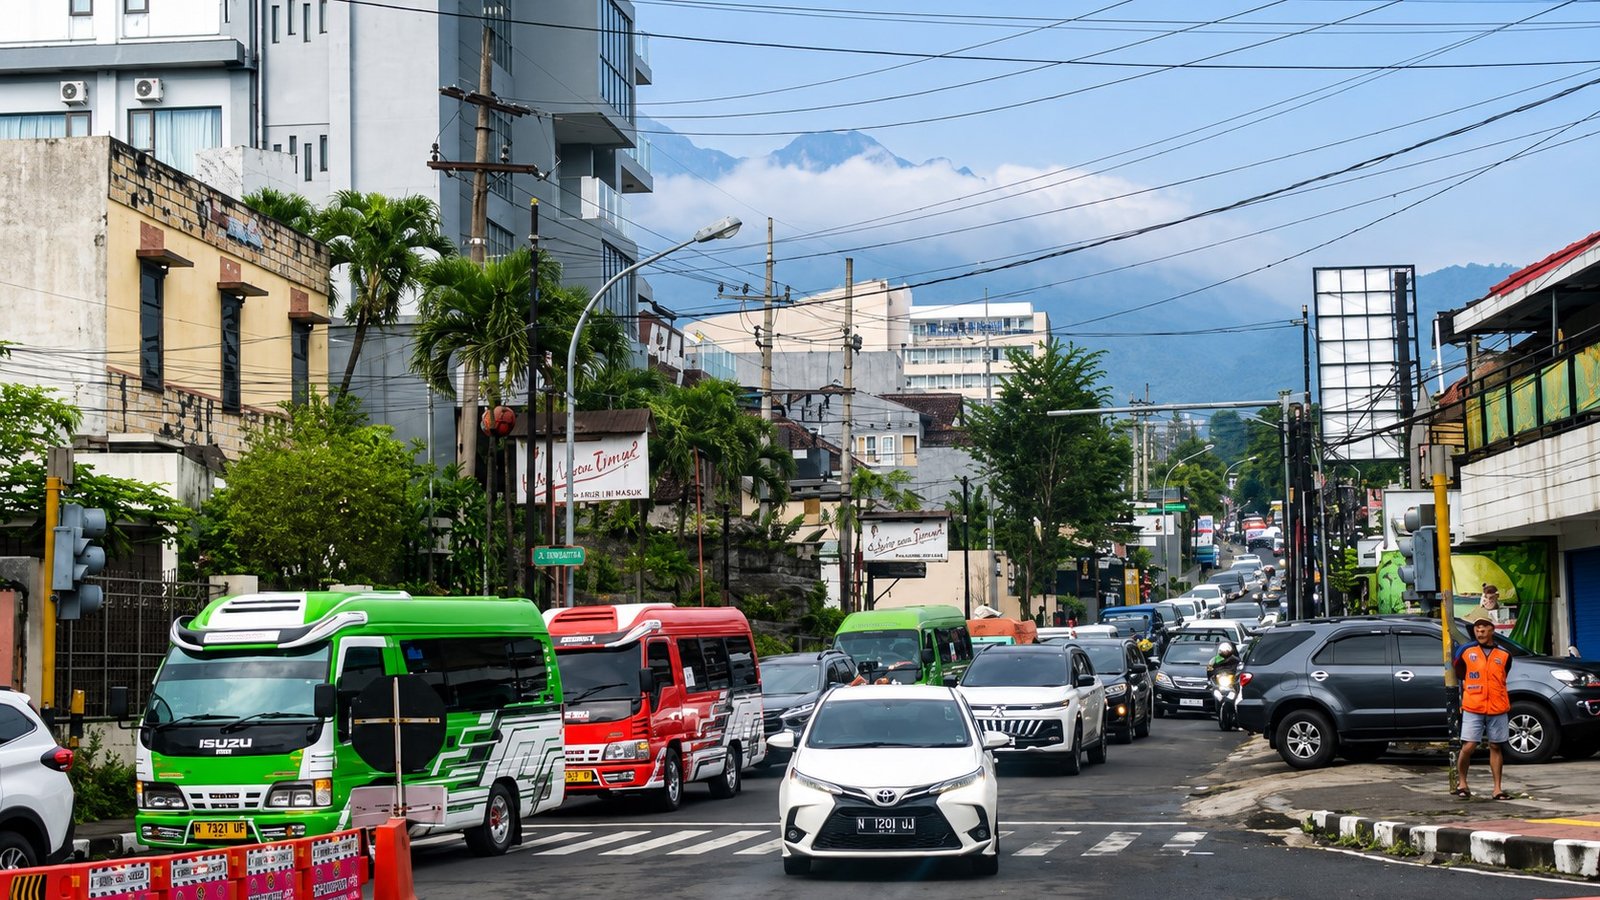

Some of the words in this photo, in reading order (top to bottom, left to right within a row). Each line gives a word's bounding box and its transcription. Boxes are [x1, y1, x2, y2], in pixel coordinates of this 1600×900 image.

[199, 738, 252, 748] ISUZU
[207, 823, 228, 834] 7321
[233, 823, 244, 834] UF
[858, 818, 864, 829] N
[875, 818, 896, 829] 1201
